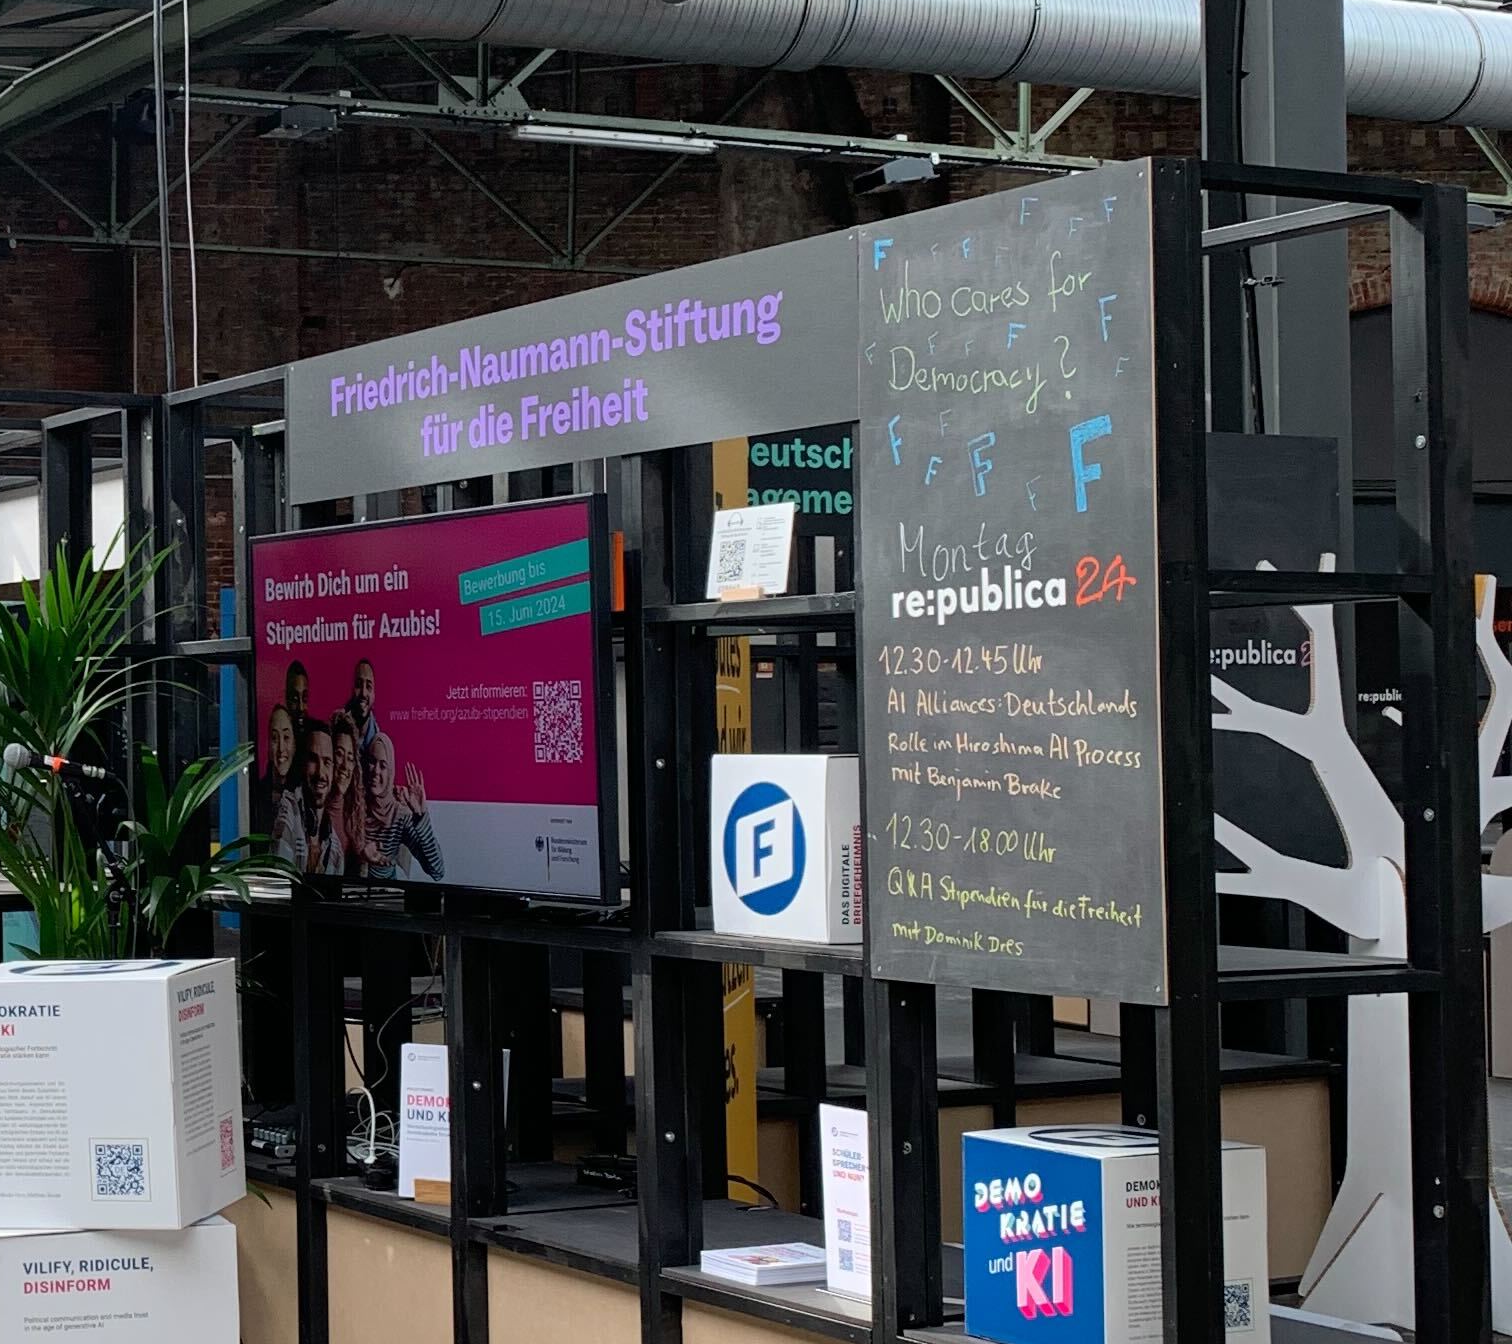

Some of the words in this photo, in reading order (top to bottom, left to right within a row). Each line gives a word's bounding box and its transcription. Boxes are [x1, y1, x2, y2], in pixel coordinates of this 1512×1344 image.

[1020, 198, 1038, 225] F
[873, 239, 894, 271] F
[1048, 251, 1092, 312] for
[1007, 322, 1026, 349] F
[1098, 294, 1118, 342] F
[330, 290, 784, 417] Friedrich-Naumann-Stiftung
[888, 346, 1047, 414] Democracy
[421, 414, 464, 456] für
[469, 404, 514, 449] die
[521, 378, 649, 441] Freiheit
[888, 415, 902, 465] F
[925, 456, 943, 485] F
[968, 432, 996, 496] F
[1069, 414, 1113, 513] F
[899, 522, 1037, 582] Montag
[265, 573, 314, 602] Bewirb
[317, 572, 351, 599] Dich
[355, 575, 380, 594] um
[384, 564, 409, 591] ein
[464, 567, 526, 596] Bewerbung
[527, 560, 546, 581] bis
[892, 565, 1067, 626] re:publica
[1076, 555, 1137, 608] 24
[266, 616, 348, 650] Stipendium
[352, 613, 375, 640] für
[379, 609, 440, 638] Azubis!
[489, 610, 506, 627] 15.
[507, 604, 533, 625] Juni
[536, 595, 566, 618] 2024
[1013, 643, 1043, 674] Uhr
[446, 686, 469, 701] Jetzt
[471, 685, 528, 700] informieren:
[1004, 688, 1138, 718] Deutschlands
[888, 732, 928, 754] Rolle
[933, 740, 952, 752] im
[956, 732, 1044, 756] Hiroshima
[1074, 739, 1141, 769] Process
[892, 762, 921, 785] mit
[928, 767, 1001, 801] Benjamin
[1004, 772, 1061, 800] Brake
[1024, 831, 1057, 863] Uhr
[841, 843, 851, 897] DIGITALE
[852, 823, 863, 926] BRIEFGEHEIMNIS
[842, 900, 851, 926] DAS
[940, 875, 1020, 910] Stipendien
[1024, 890, 1048, 918] für
[892, 920, 921, 940] mit
[924, 925, 984, 951] Dominik
[1, 1024, 15, 1036] KI
[407, 1109, 433, 1121] UND
[974, 1172, 1043, 1212] DEMO
[1126, 1197, 1147, 1209] UND
[1000, 1200, 1087, 1244] KRATIE
[23, 1261, 74, 1276] VILIFY,
[79, 1256, 154, 1273] RIDICULE,
[988, 1253, 1013, 1274] und
[23, 1278, 111, 1294] DISINFORM
[1016, 1246, 1073, 1320] KI
